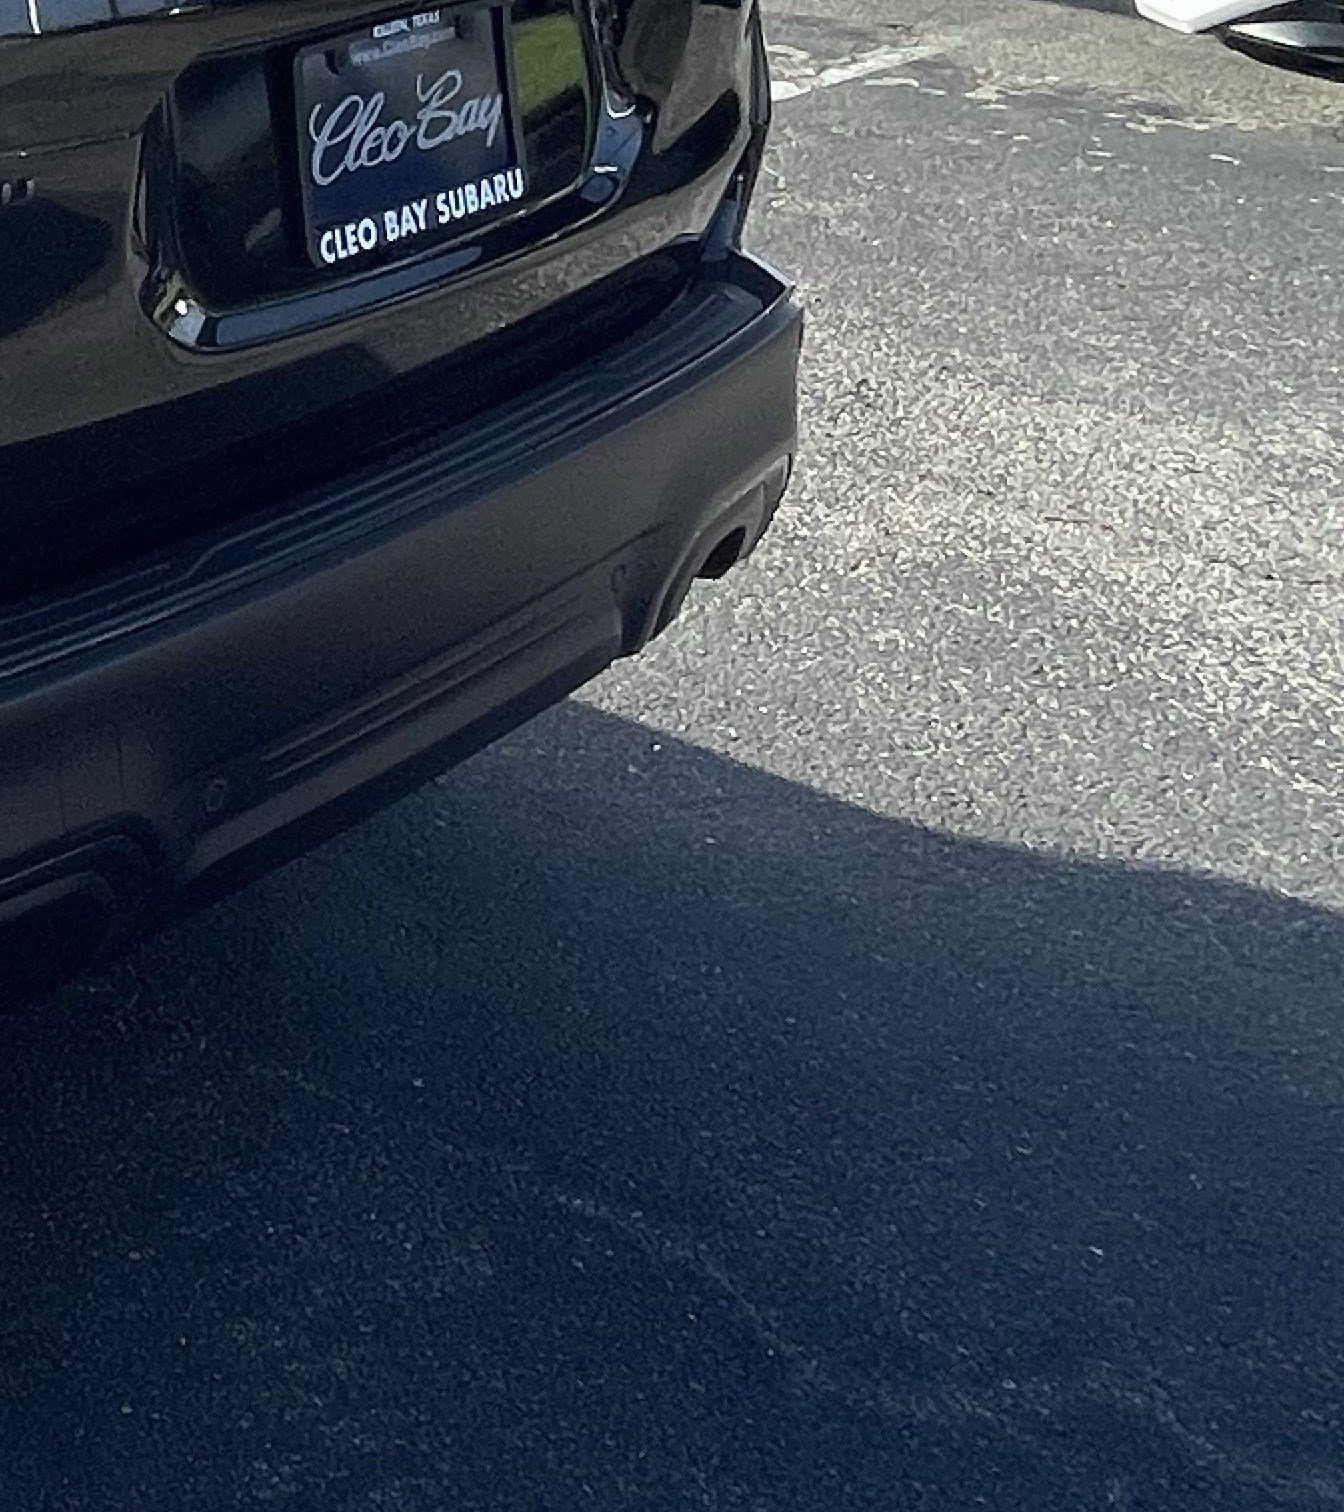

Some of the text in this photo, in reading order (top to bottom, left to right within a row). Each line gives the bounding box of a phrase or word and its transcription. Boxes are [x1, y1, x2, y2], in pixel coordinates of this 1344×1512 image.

[309, 69, 503, 186] Cleo Bay
[320, 168, 524, 263] CLEO BAY SUBARU
